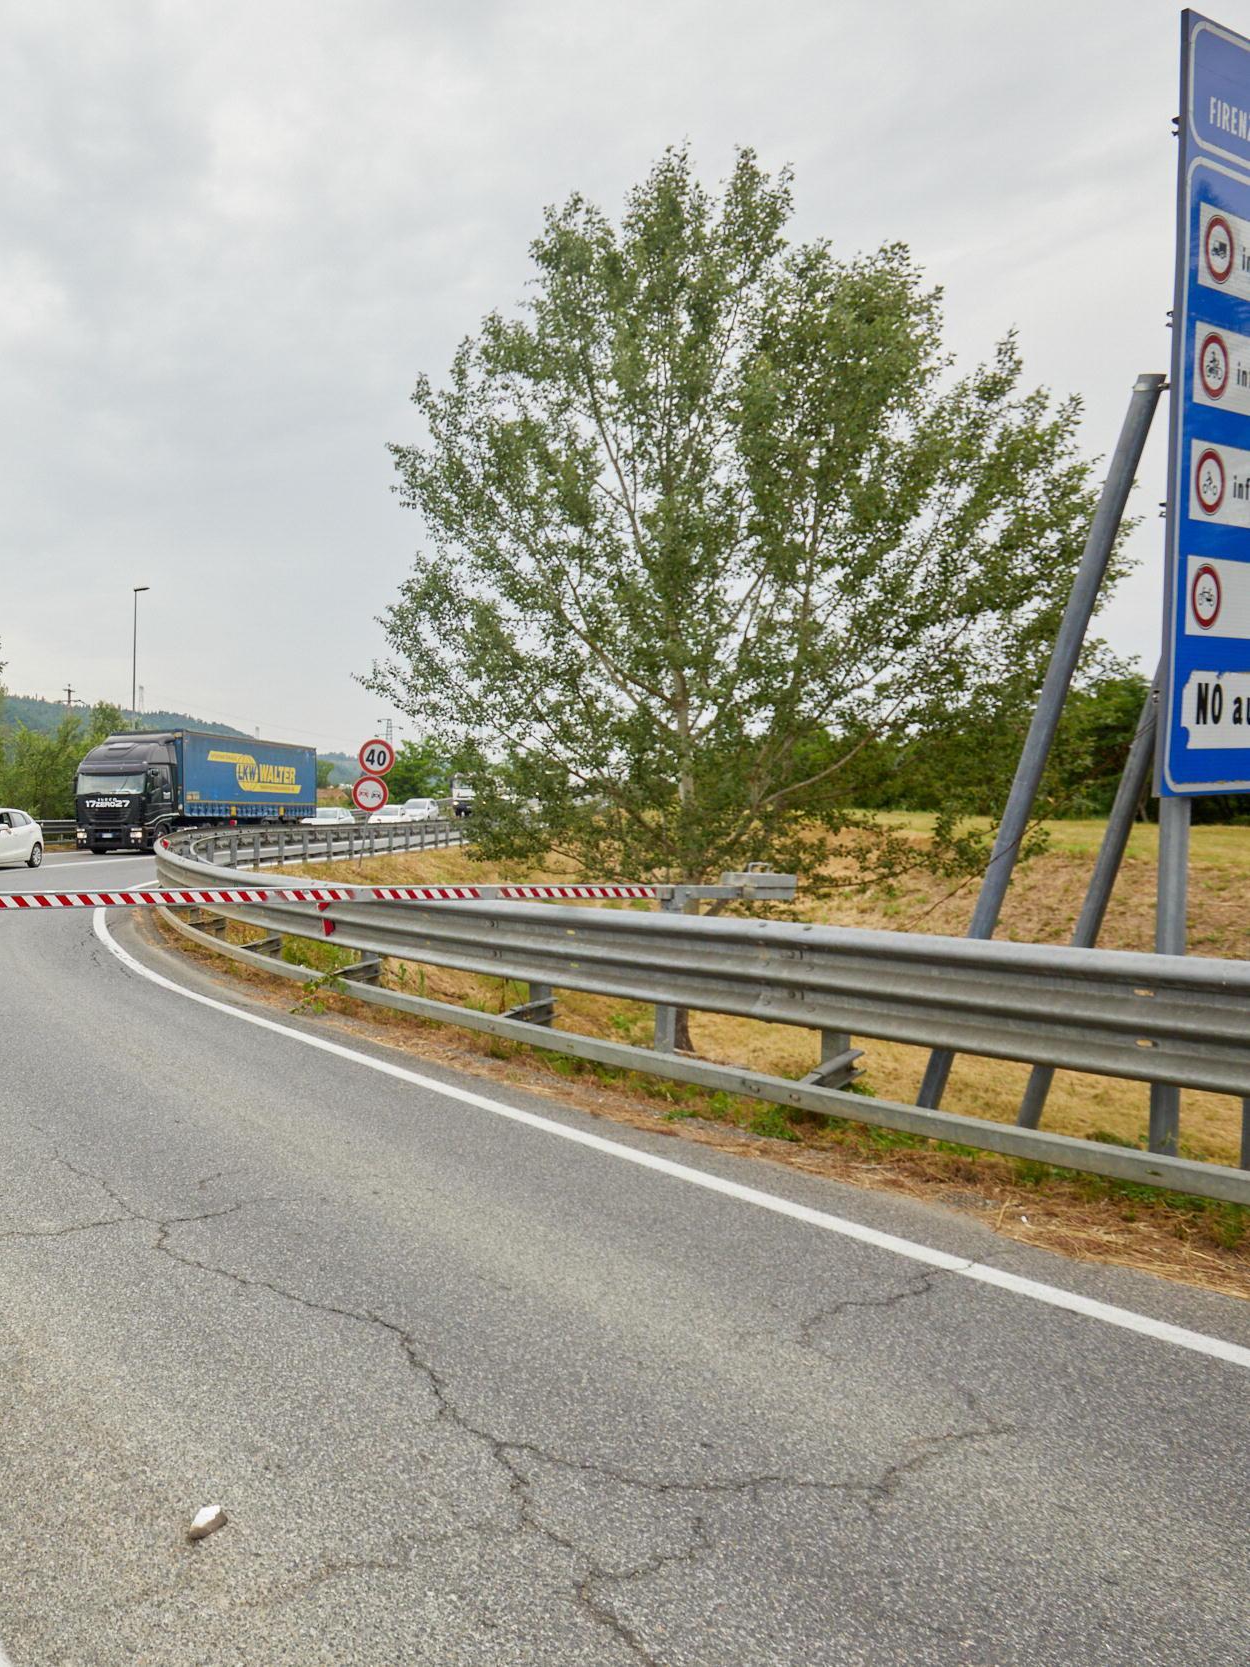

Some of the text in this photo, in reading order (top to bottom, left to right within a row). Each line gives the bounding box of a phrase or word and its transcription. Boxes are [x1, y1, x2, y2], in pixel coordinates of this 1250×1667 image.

[1237, 361, 1250, 388] in
[1195, 682, 1223, 725] NO
[366, 748, 387, 767] 40
[237, 763, 296, 785] LKW WALTER
